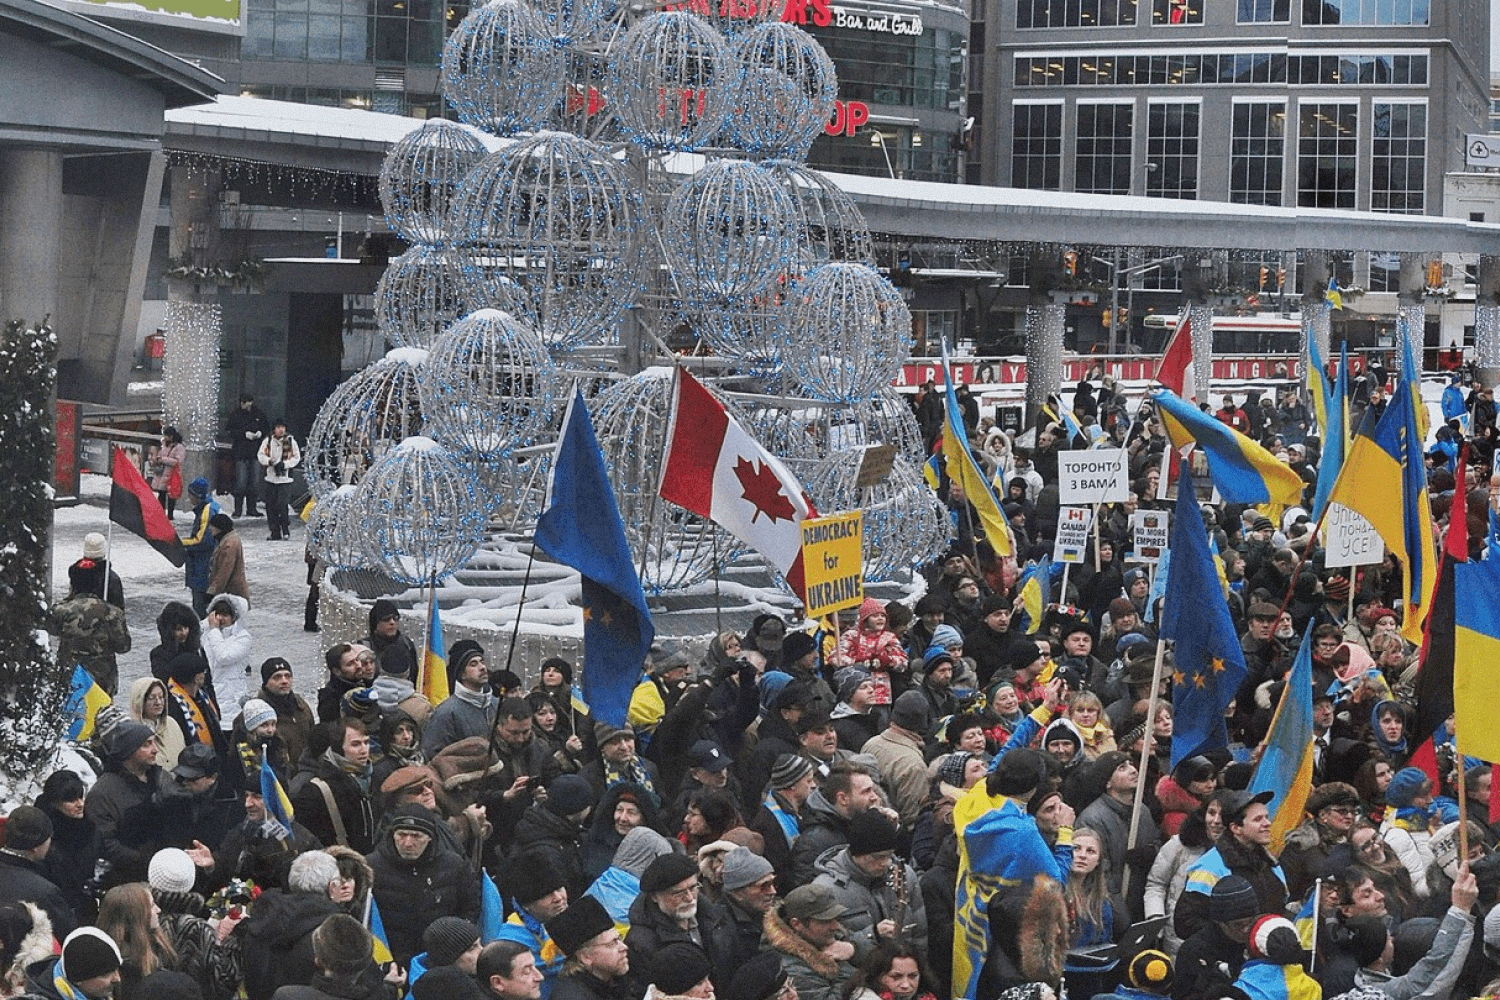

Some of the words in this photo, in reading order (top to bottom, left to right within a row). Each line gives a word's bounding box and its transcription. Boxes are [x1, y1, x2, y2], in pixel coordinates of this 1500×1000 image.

[834, 9, 862, 28] Bar
[867, 16, 888, 31] and
[891, 18, 924, 36] Grill
[896, 367, 964, 386] ARE
[1010, 365, 1072, 384] YU
[1112, 362, 1260, 381] MIING
[1065, 462, 1121, 474] ТОРОНТО
[1081, 479, 1117, 489] ВАМИ
[1060, 522, 1087, 531] CANADA
[803, 520, 859, 546] DEMOCRACY
[1147, 529, 1166, 537] MORE
[1059, 538, 1085, 547] UKRAINE
[1136, 537, 1166, 547] EMPIRES
[823, 551, 839, 571] for
[807, 573, 861, 611] UKRAINE
